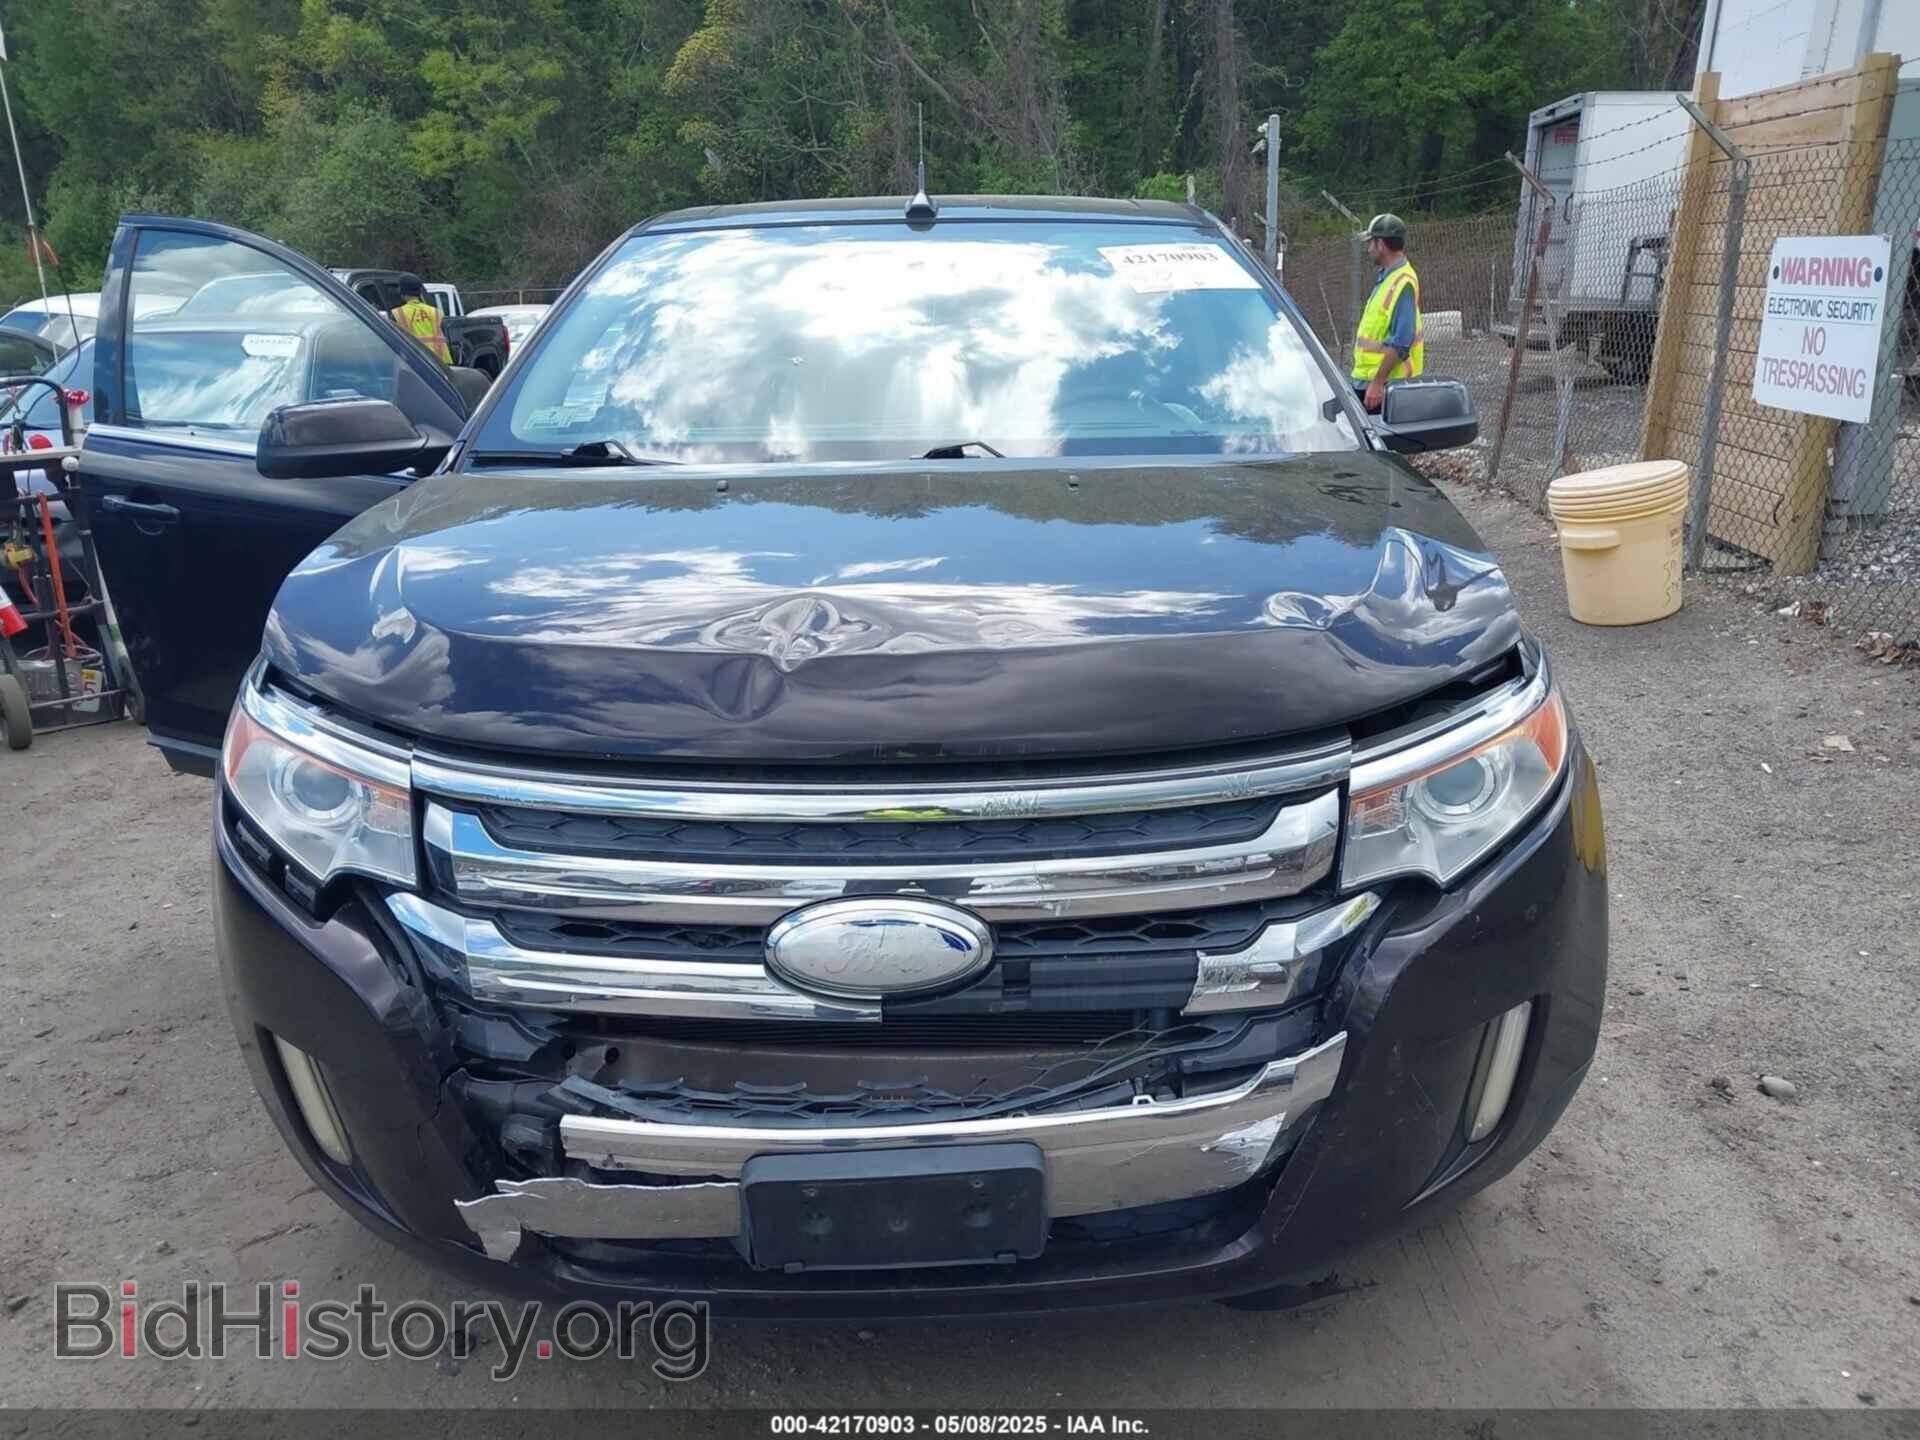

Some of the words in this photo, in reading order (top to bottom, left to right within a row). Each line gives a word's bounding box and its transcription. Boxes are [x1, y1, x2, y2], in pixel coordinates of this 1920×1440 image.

[1780, 256, 1873, 288] WARNING
[1768, 297, 1824, 317] ELECTRONIC
[1826, 302, 1878, 321] SECURITY
[1801, 326, 1826, 356] NO
[1762, 357, 1867, 399] TRESPASSING
